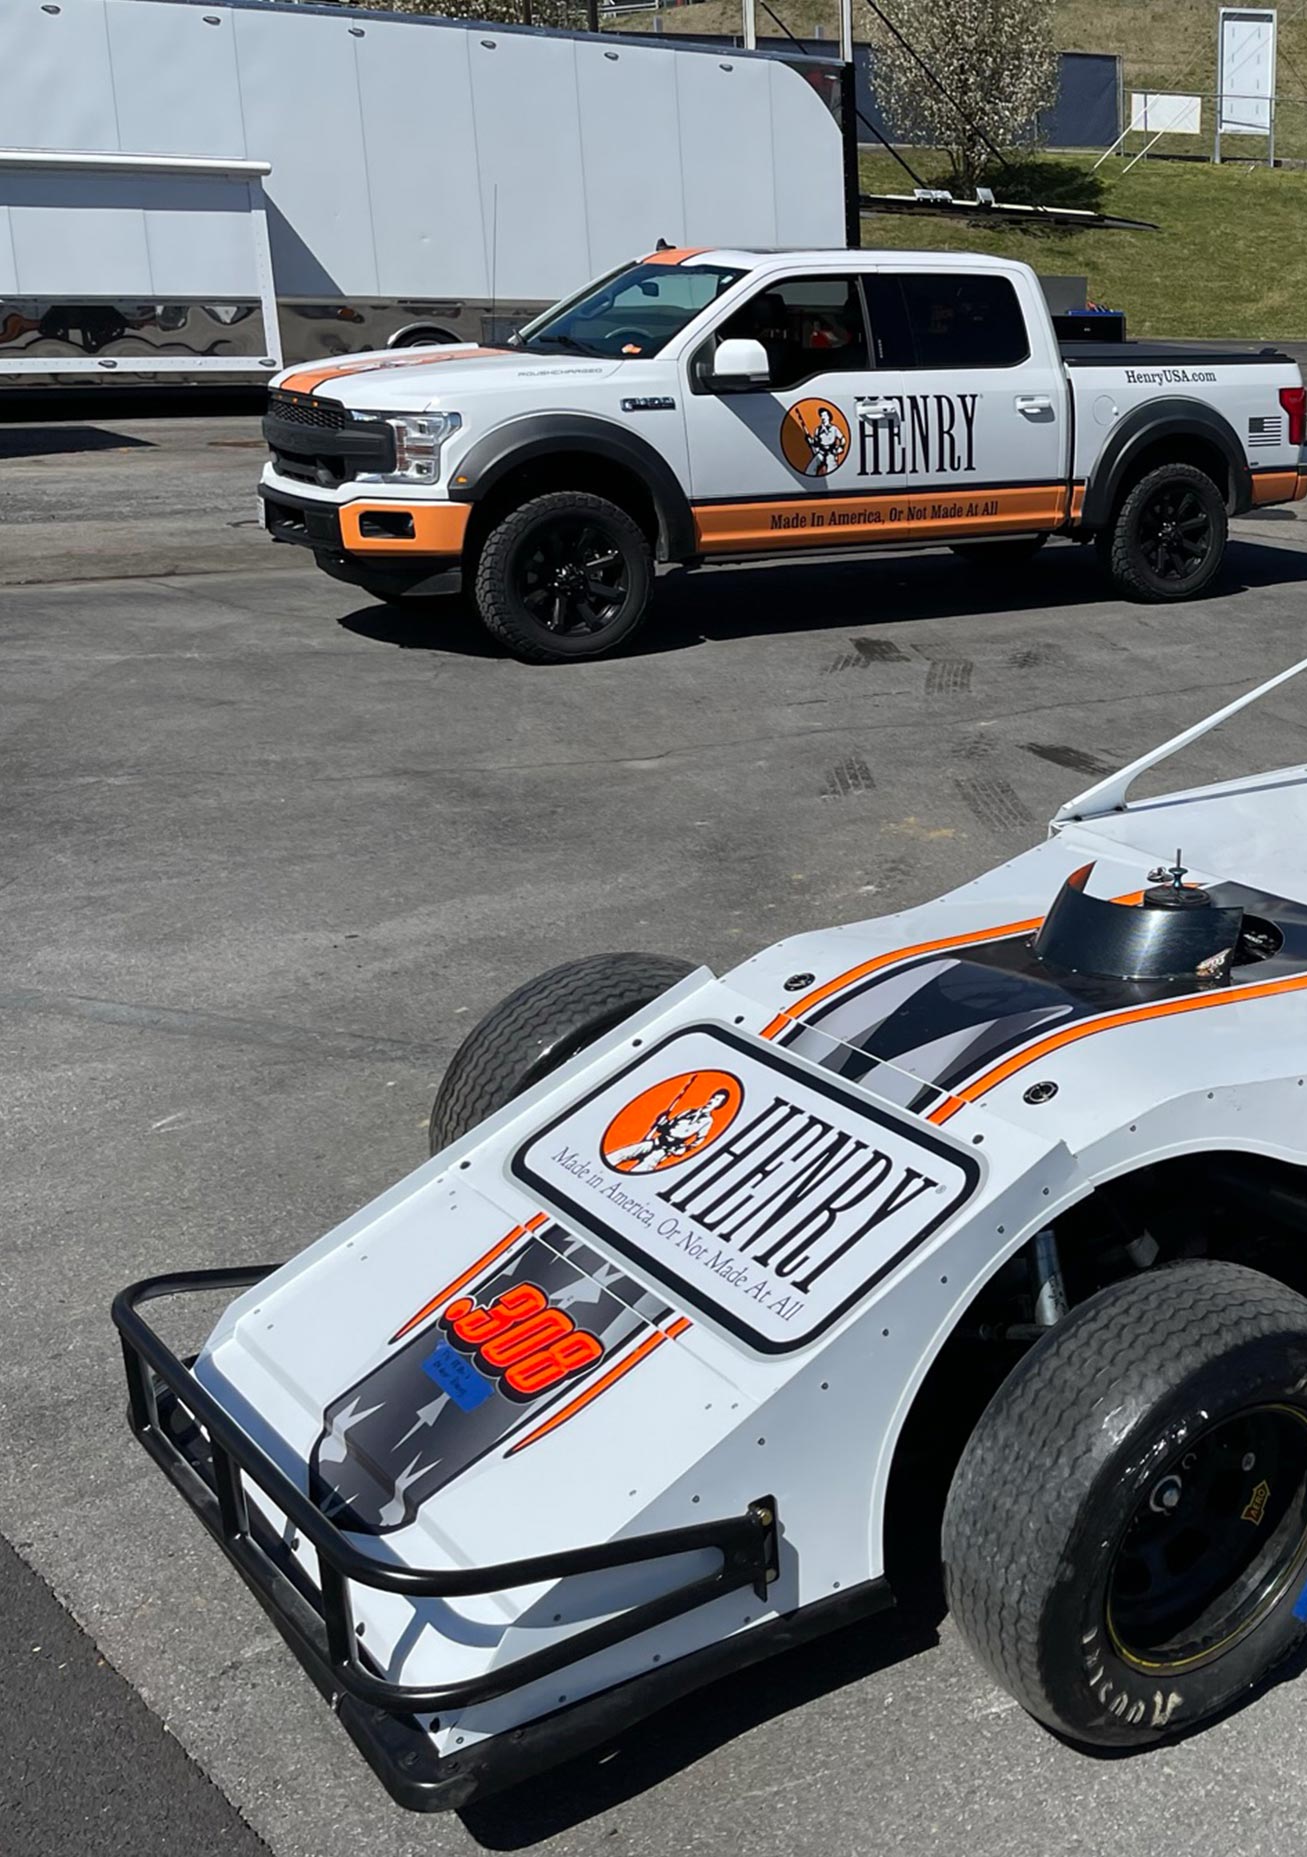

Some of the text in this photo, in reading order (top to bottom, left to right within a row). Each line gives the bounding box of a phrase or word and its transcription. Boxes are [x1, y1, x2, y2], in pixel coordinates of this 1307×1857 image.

[1125, 369, 1217, 386] HenryUSA.com
[854, 393, 978, 476] HENRY
[770, 501, 998, 530] Made In America, Or Not Made At All
[551, 1146, 806, 1322] Made in America, Or Not Made At All
[656, 1096, 939, 1295] HENRY
[445, 1283, 604, 1394] .308
